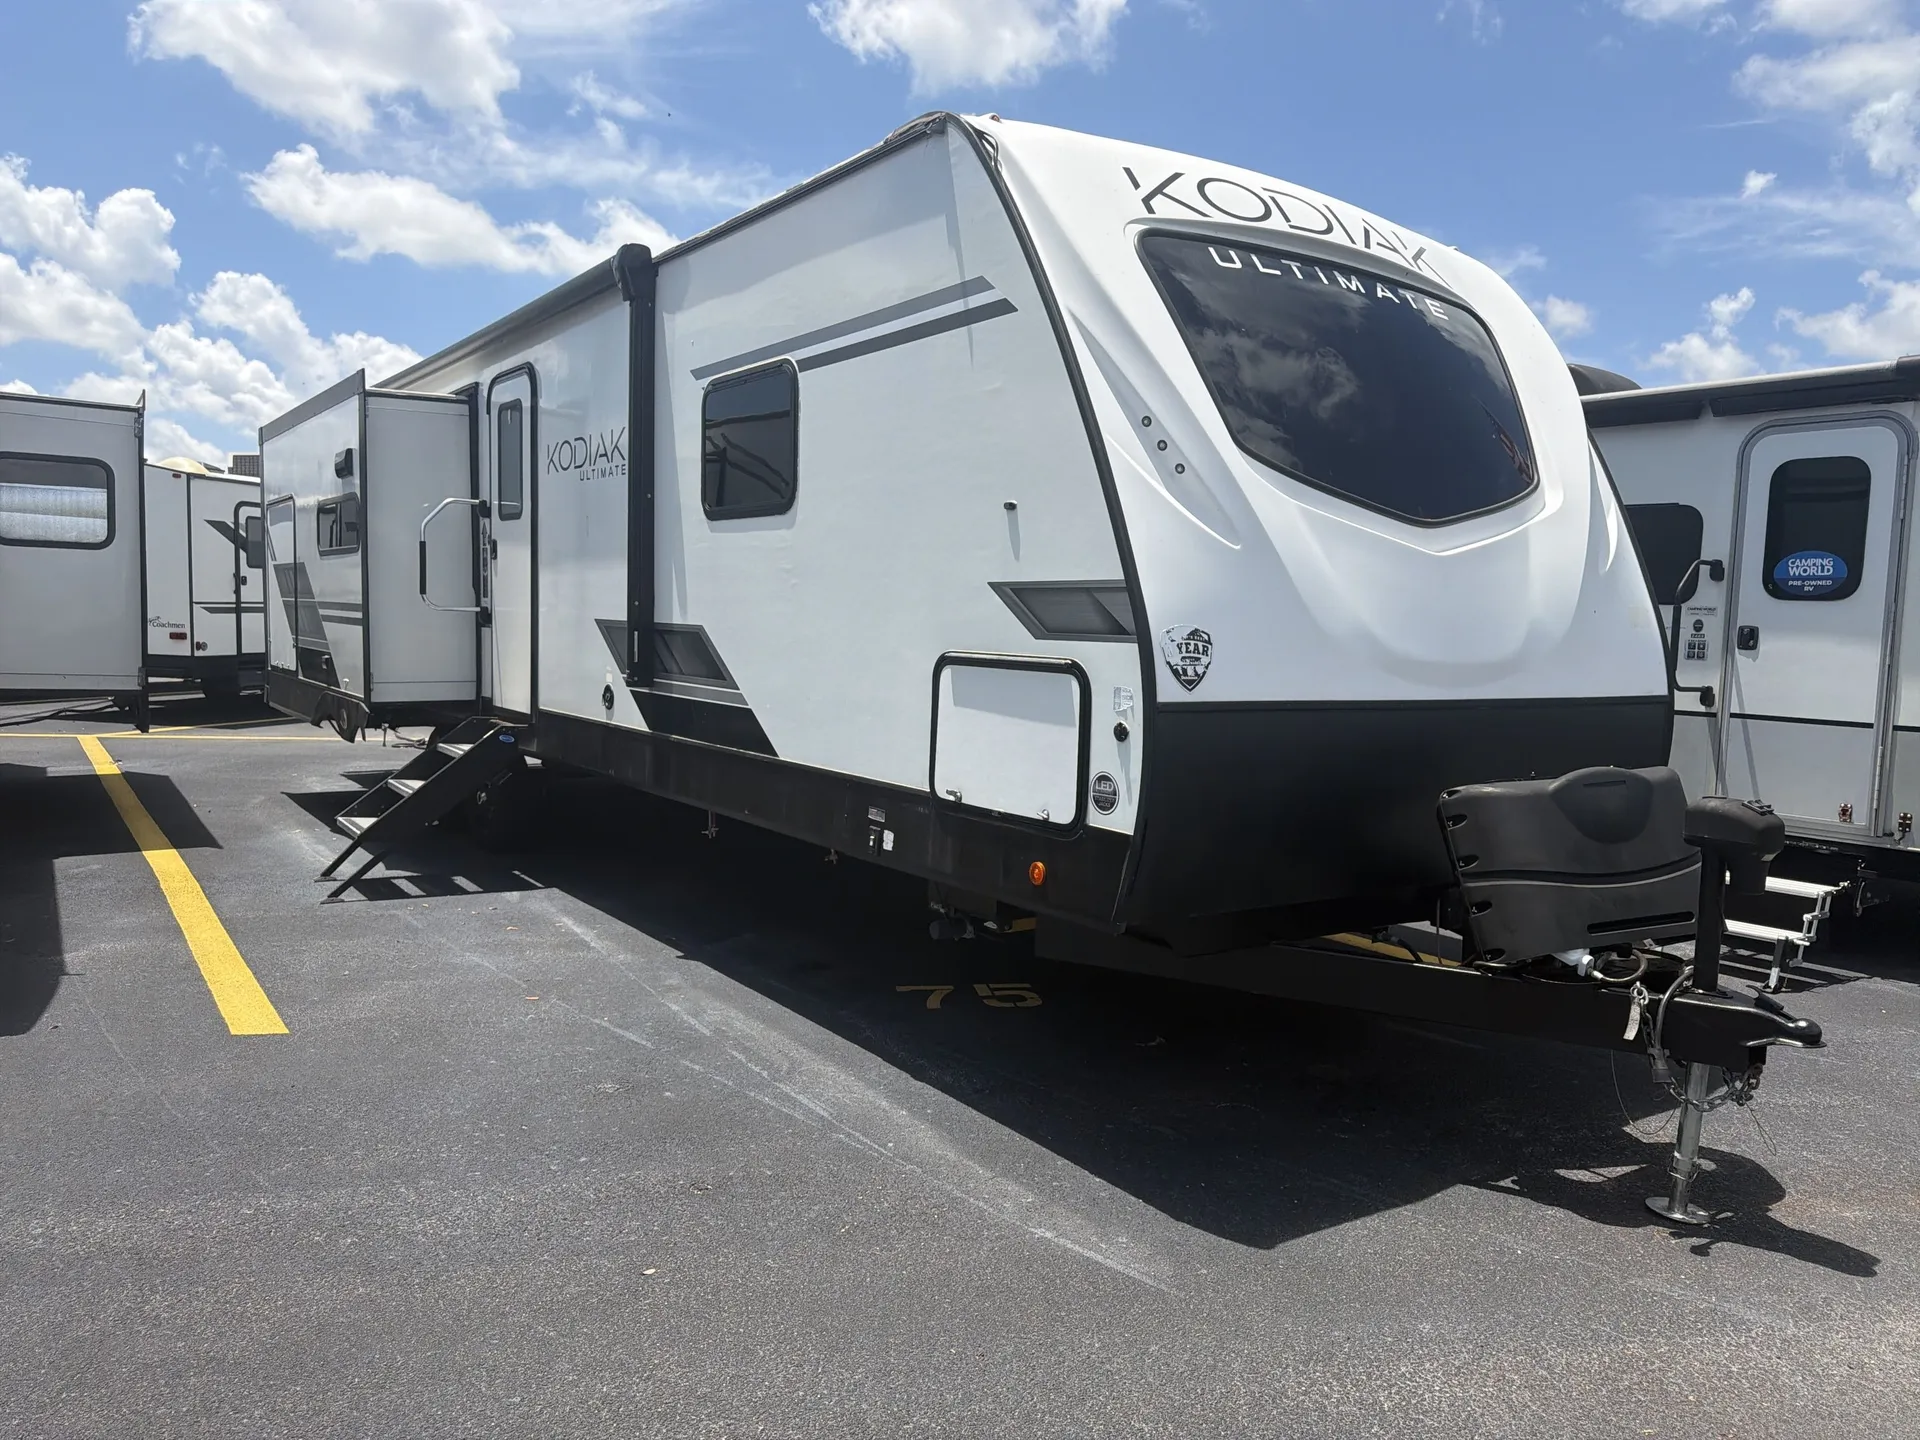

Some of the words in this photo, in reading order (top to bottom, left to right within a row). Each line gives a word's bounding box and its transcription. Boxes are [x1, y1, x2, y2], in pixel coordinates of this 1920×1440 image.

[1122, 166, 1455, 289] KODIAK
[1208, 246, 1450, 321] ULTIMATE
[547, 426, 626, 475] KODIAK
[579, 464, 626, 481] ULTIMATE
[1788, 558, 1834, 567] CAMPING
[1788, 566, 1834, 577] WORLD
[152, 621, 186, 629] Coachmen
[1176, 642, 1210, 657] YEAR
[1095, 780, 1114, 792] LED
